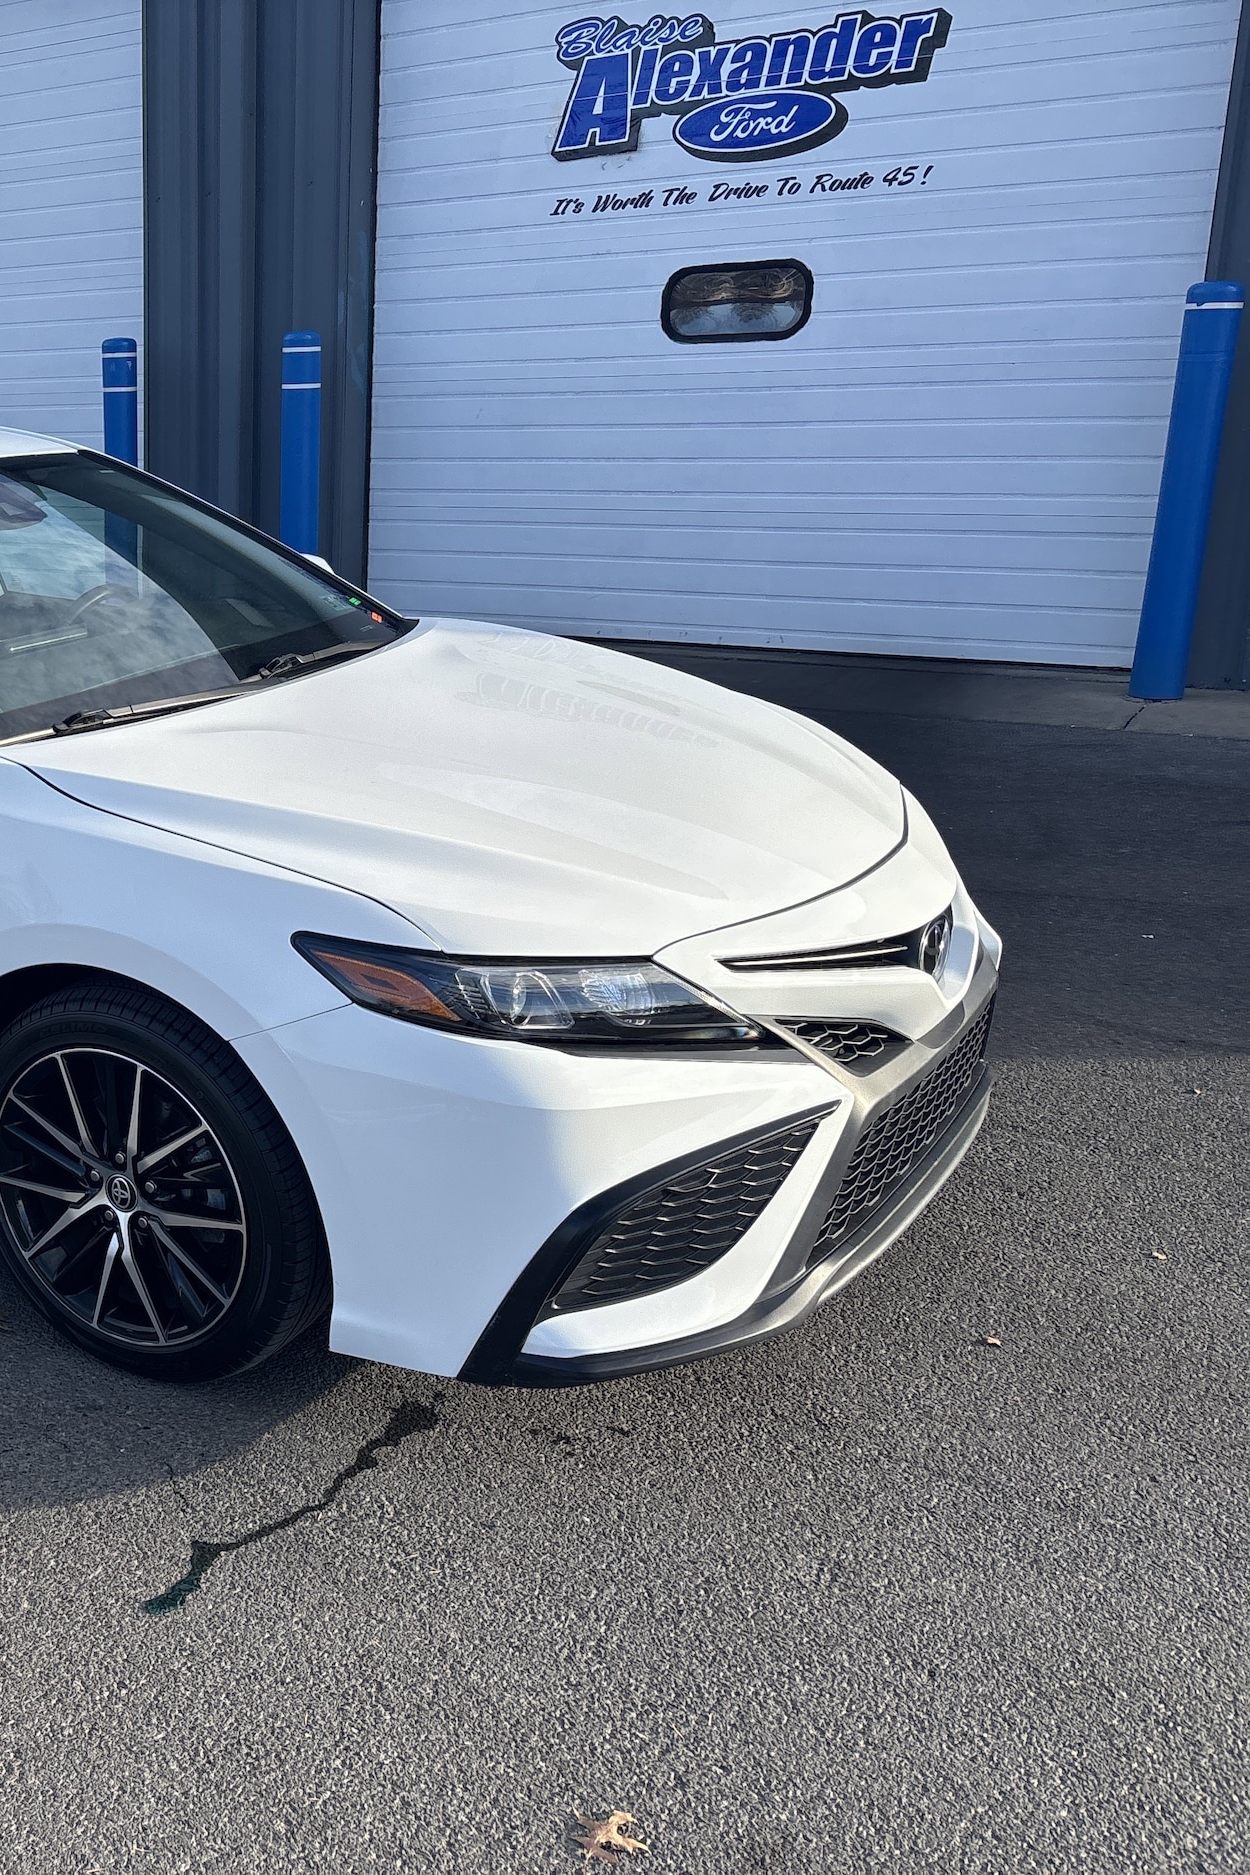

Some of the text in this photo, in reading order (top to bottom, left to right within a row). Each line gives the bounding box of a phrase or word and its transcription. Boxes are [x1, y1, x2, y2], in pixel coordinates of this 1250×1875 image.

[557, 13, 706, 61] Blaise
[553, 10, 945, 154] Alexander
[709, 101, 797, 143] Ford
[550, 197, 585, 217] It's
[592, 189, 654, 214] Worth
[661, 186, 699, 208] The
[708, 181, 768, 203] Drive
[776, 176, 802, 196] To
[809, 171, 875, 194] Route
